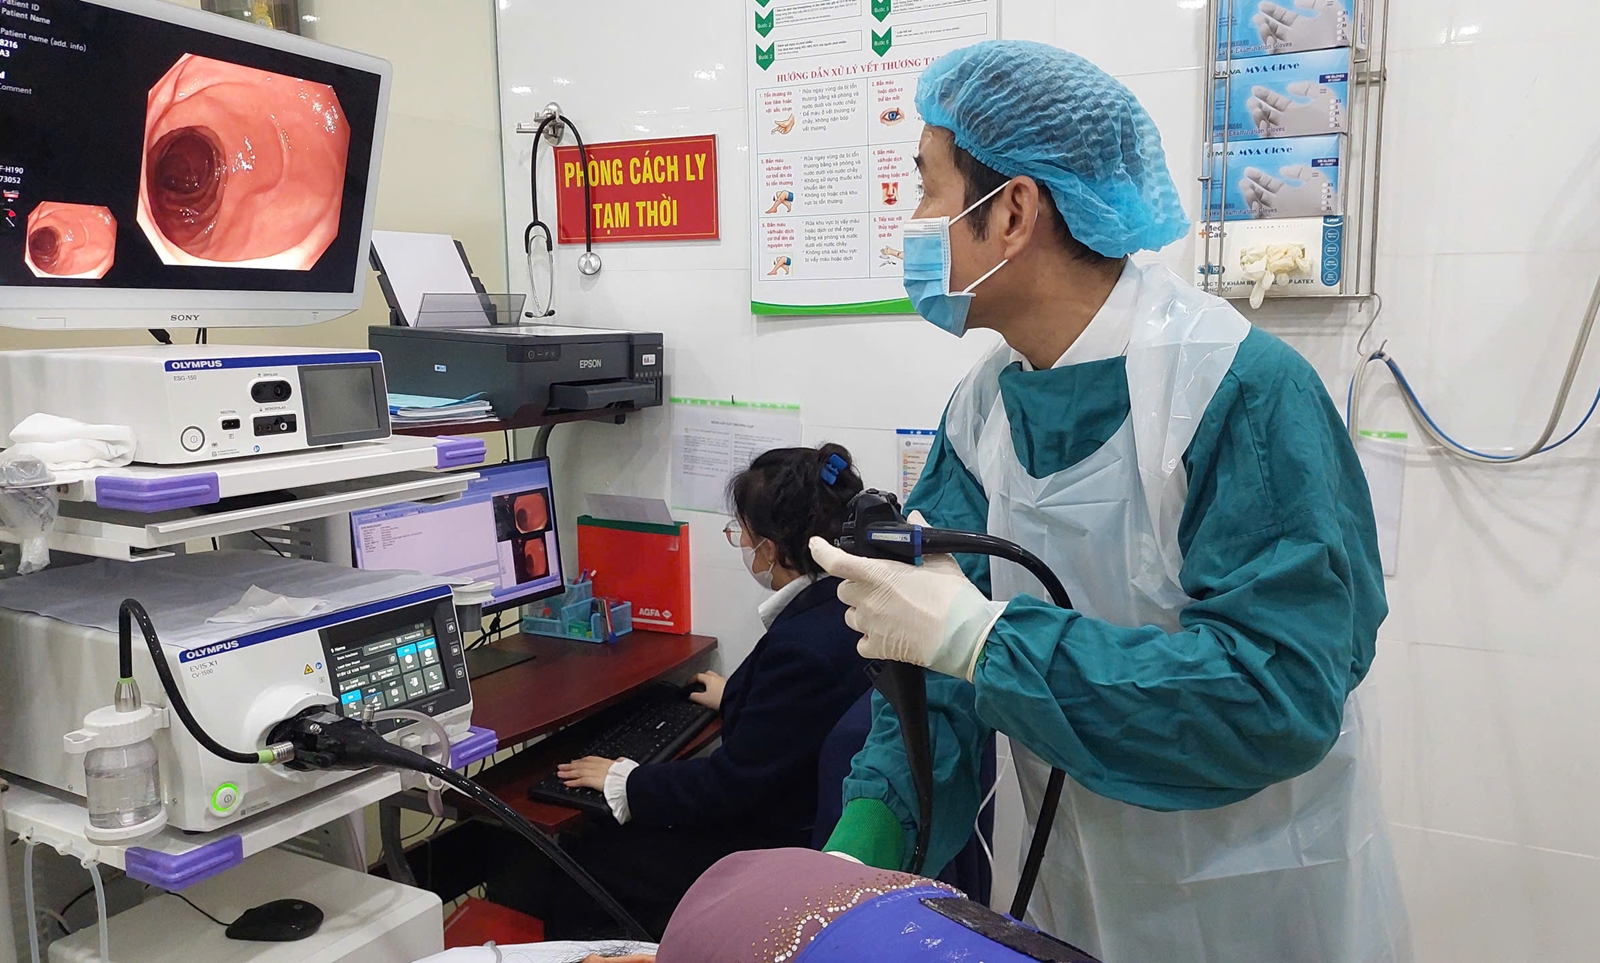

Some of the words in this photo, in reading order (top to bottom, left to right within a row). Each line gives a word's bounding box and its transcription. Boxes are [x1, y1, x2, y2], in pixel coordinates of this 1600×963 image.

[2, 8, 28, 19] Patient
[30, 14, 50, 24] Name
[1, 28, 27, 39] Patient
[29, 35, 48, 43] name
[70, 43, 86, 52] info)
[1236, 44, 1272, 53] Examination
[564, 155, 624, 188] PHÒNG
[629, 150, 678, 185] CÁCH
[686, 153, 707, 181] LY
[593, 202, 630, 234] TẠM
[636, 193, 678, 227] THỜI
[171, 360, 222, 369] OLYMPUS
[580, 359, 601, 368] EPSON
[639, 608, 660, 617] AGFA
[186, 640, 239, 659] OLYMPUS
[190, 663, 207, 672] EVIS
[192, 669, 213, 678] CV-1500
